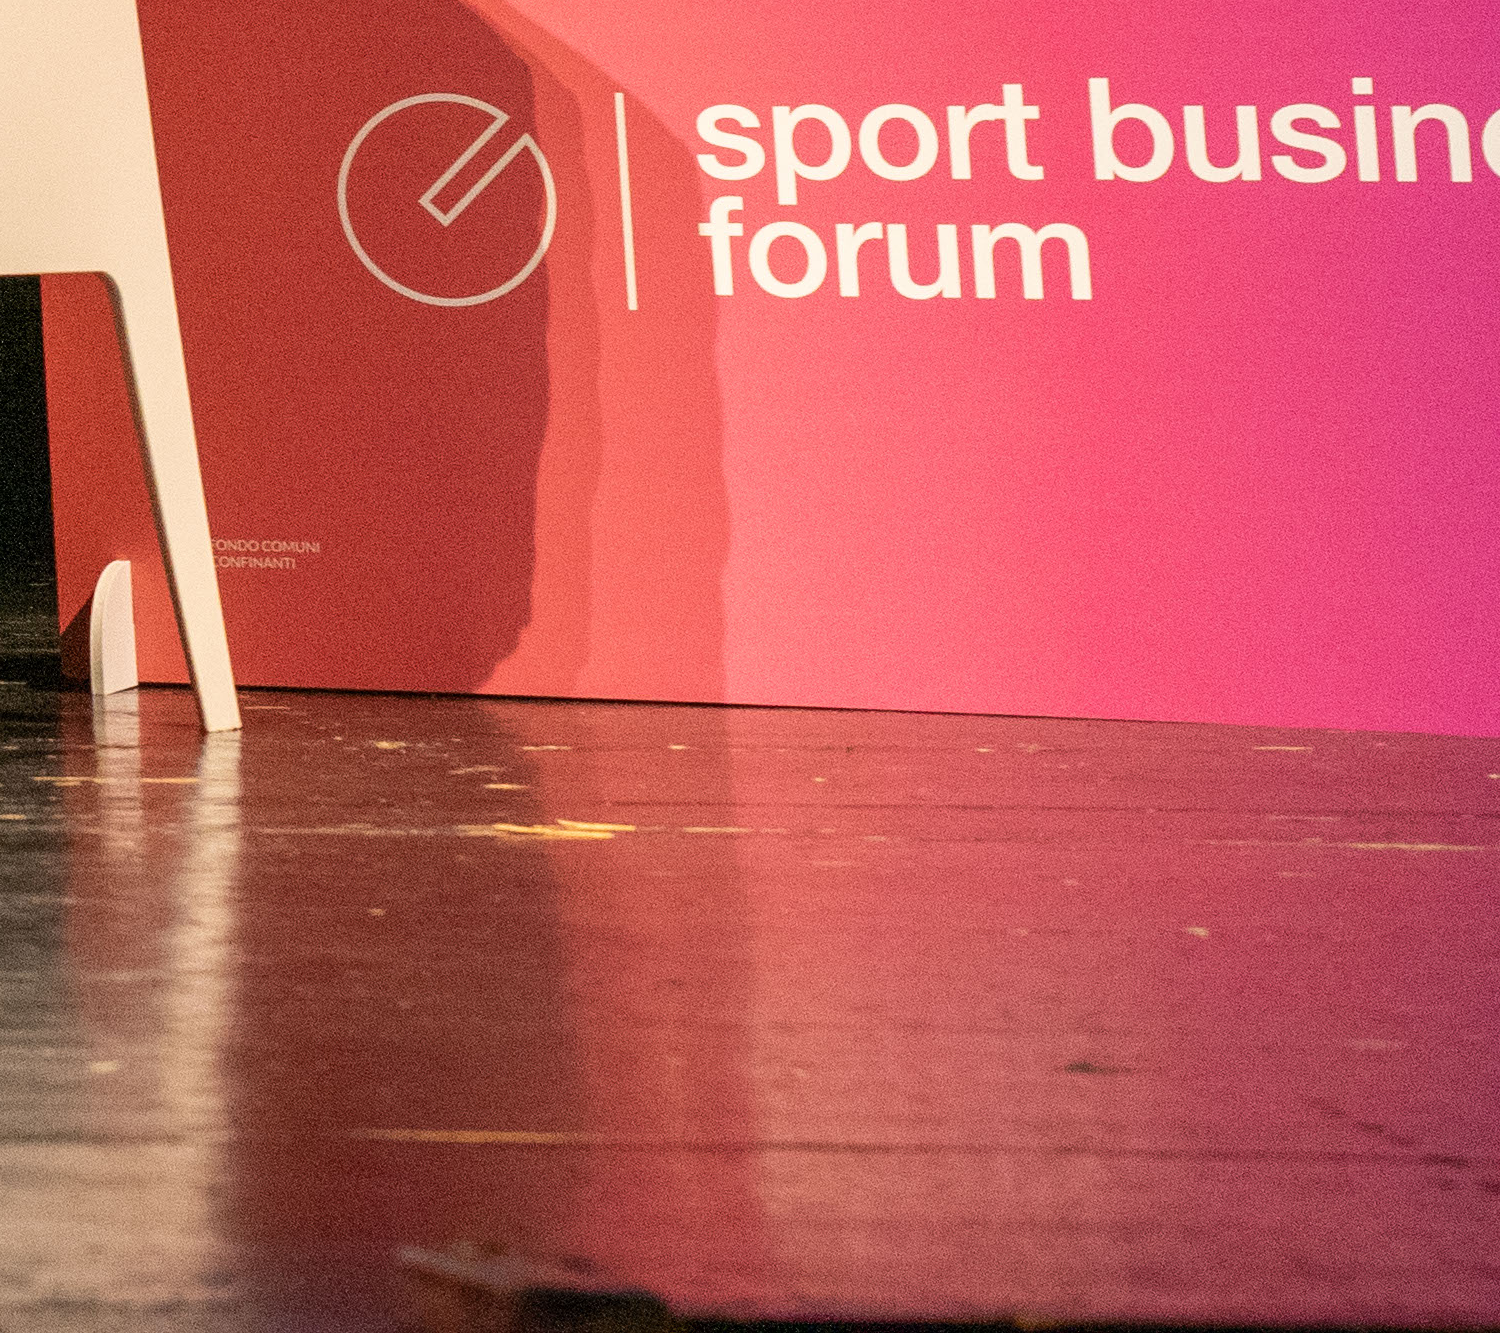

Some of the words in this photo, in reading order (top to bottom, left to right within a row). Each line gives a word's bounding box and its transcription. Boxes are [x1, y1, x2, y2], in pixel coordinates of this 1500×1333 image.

[696, 83, 1044, 205] sport
[699, 196, 1093, 300] forum
[262, 540, 320, 553] COMUNI
